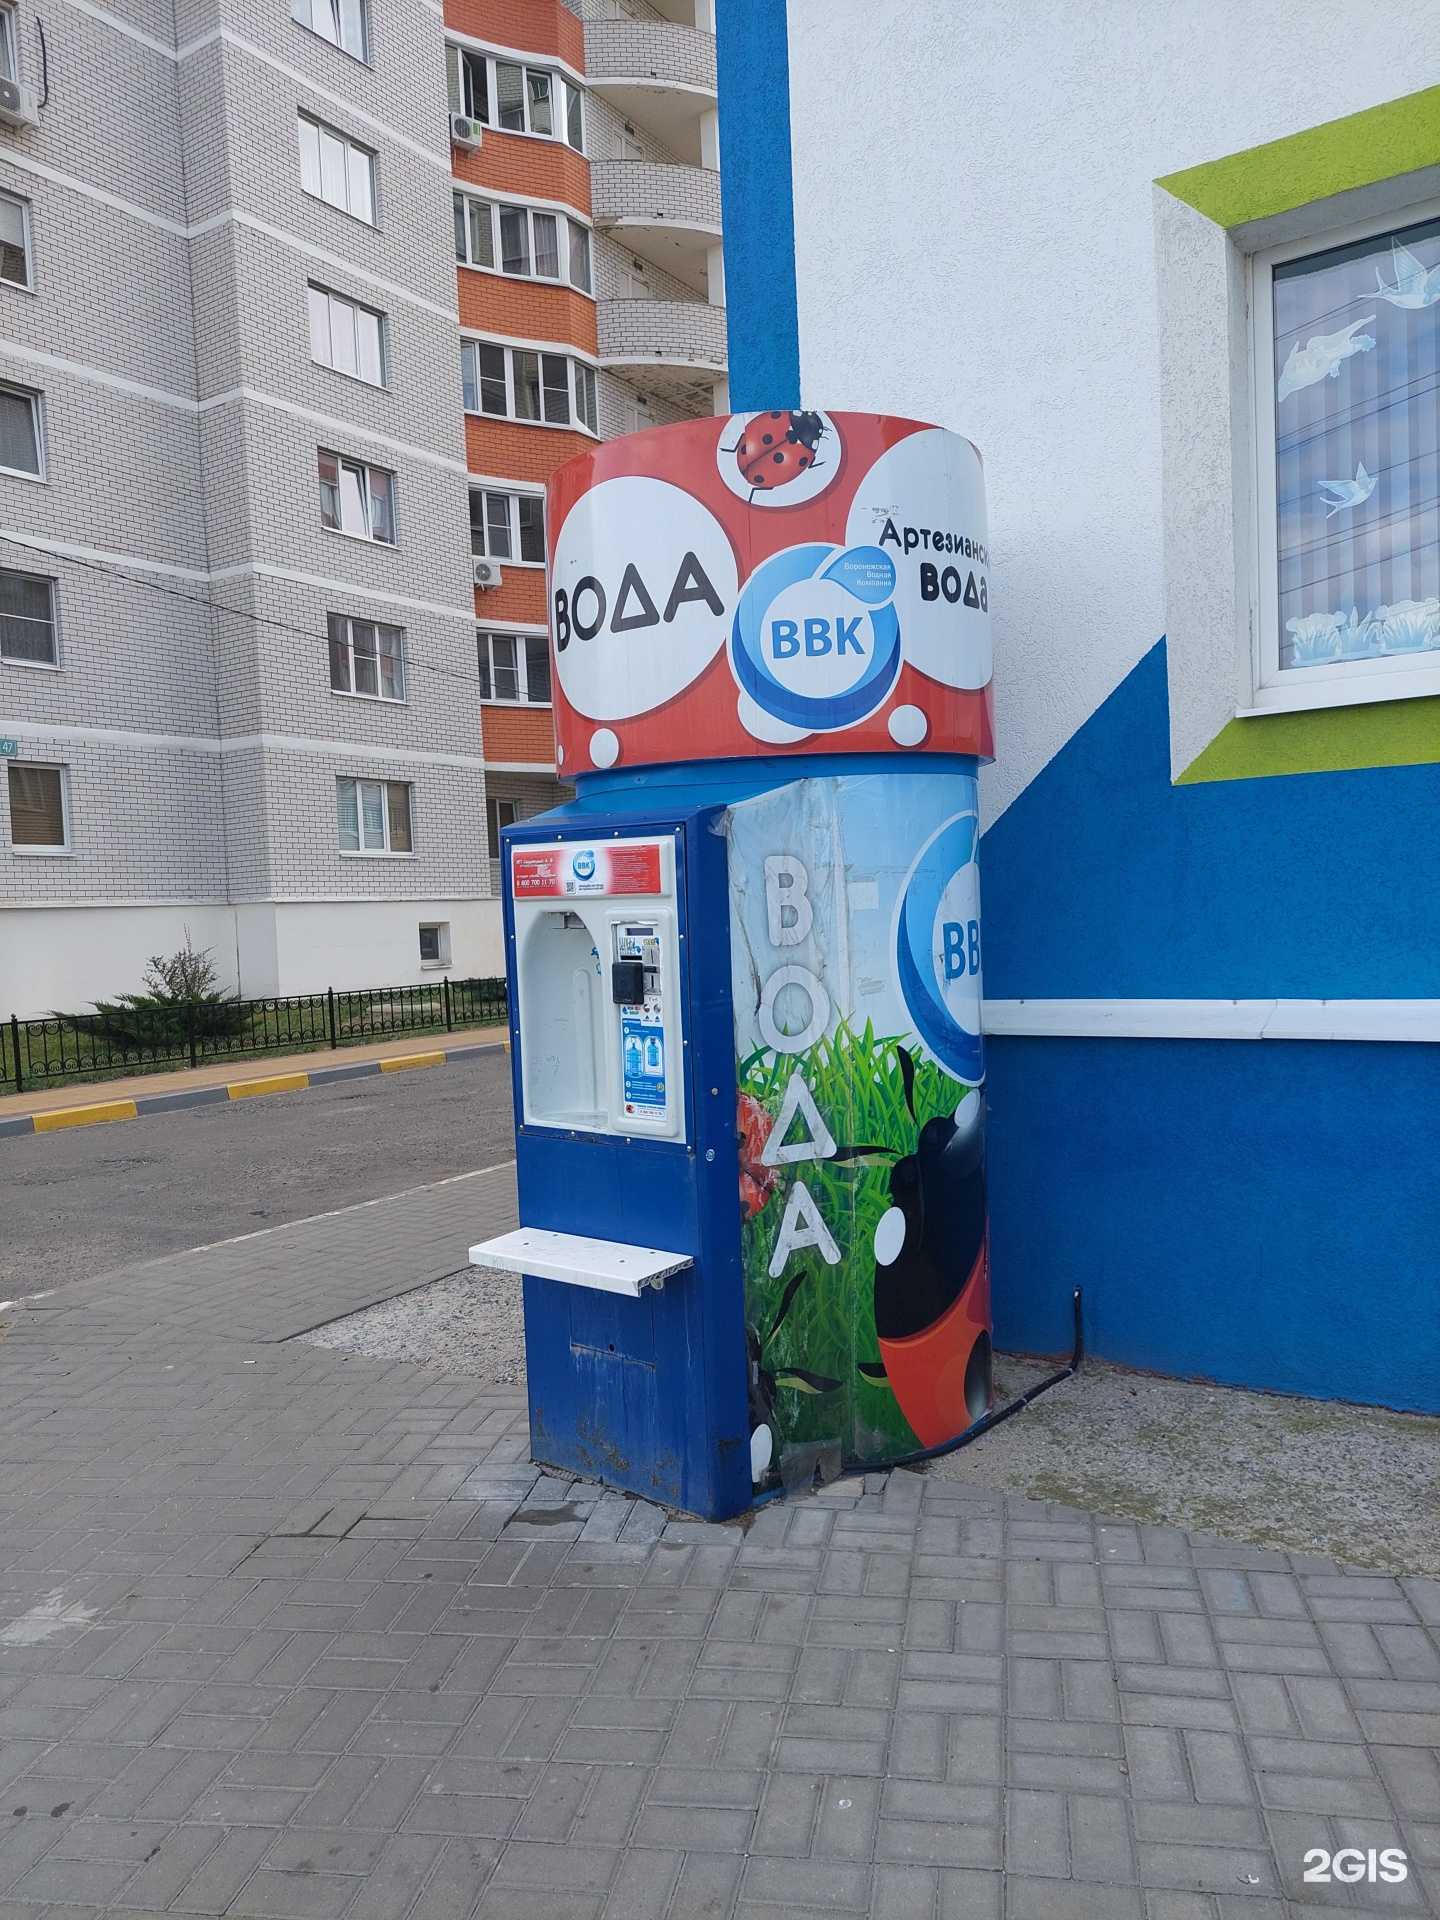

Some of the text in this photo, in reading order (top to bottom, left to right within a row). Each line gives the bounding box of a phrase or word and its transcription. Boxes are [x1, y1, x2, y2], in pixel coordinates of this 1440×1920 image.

[554, 551, 725, 653] ВОДА
[770, 616, 866, 659] ВВК
[2, 741, 12, 753] 47
[758, 855, 842, 1279] ВОДА
